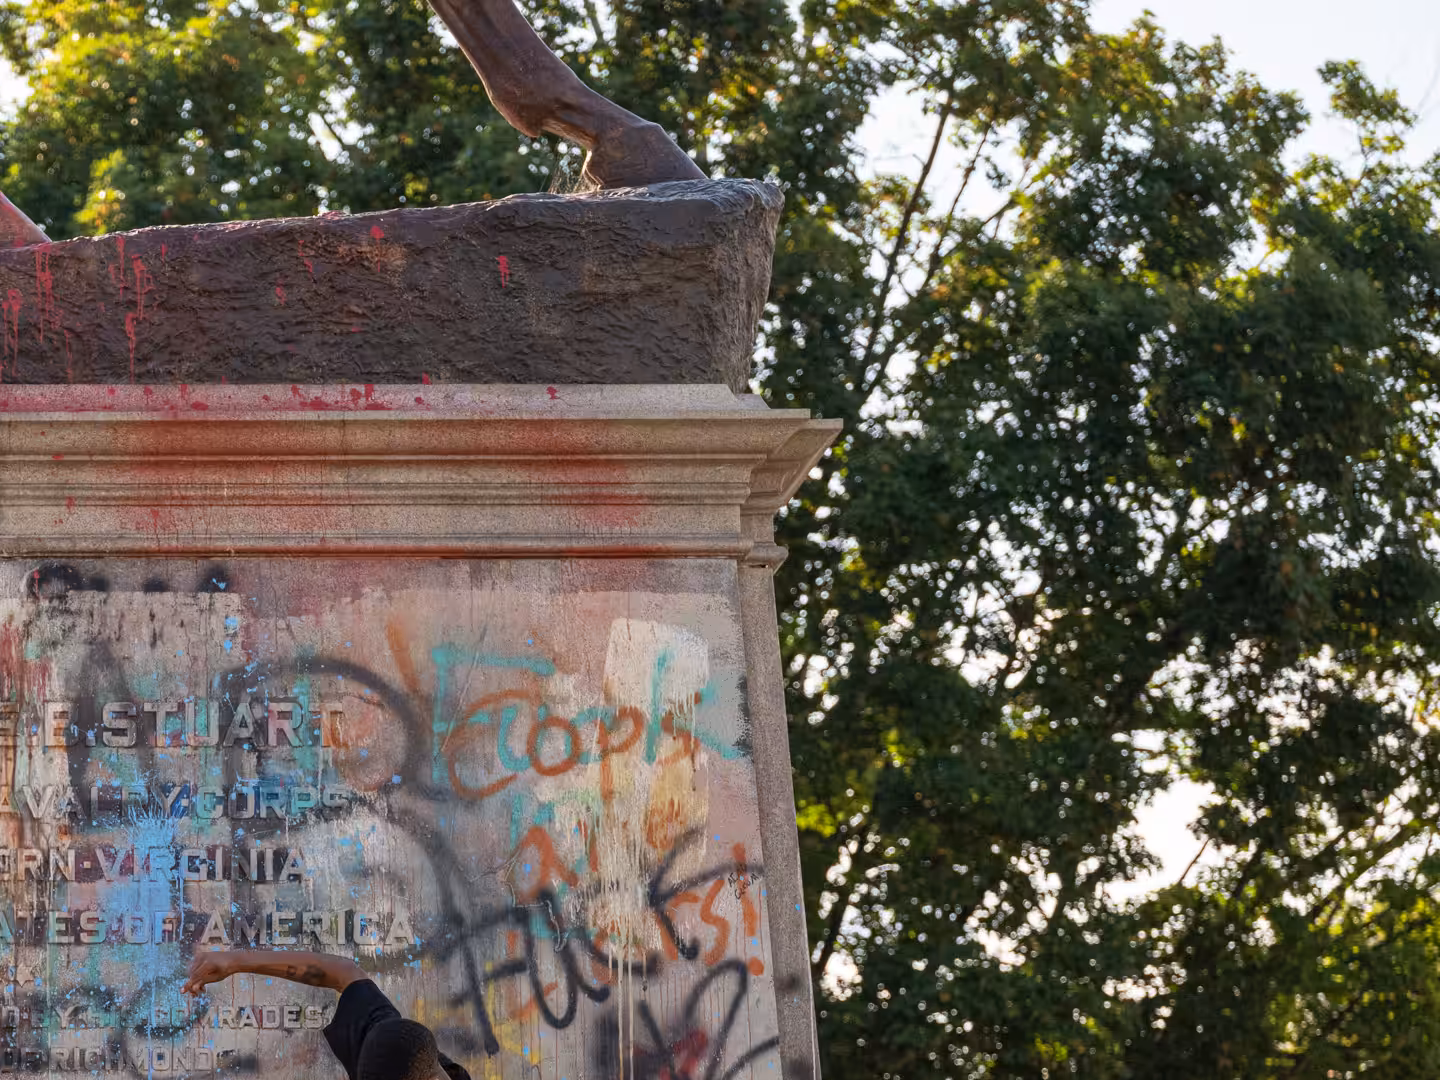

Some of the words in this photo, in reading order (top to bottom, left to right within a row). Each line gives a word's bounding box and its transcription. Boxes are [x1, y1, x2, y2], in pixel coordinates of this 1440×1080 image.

[101, 700, 344, 748] STUART
[195, 785, 350, 820] CORPS
[93, 847, 309, 883] VIRGINIA
[124, 909, 178, 945] OF
[200, 909, 420, 946] AMERICA
[50, 1047, 212, 1073] RICHMOND
